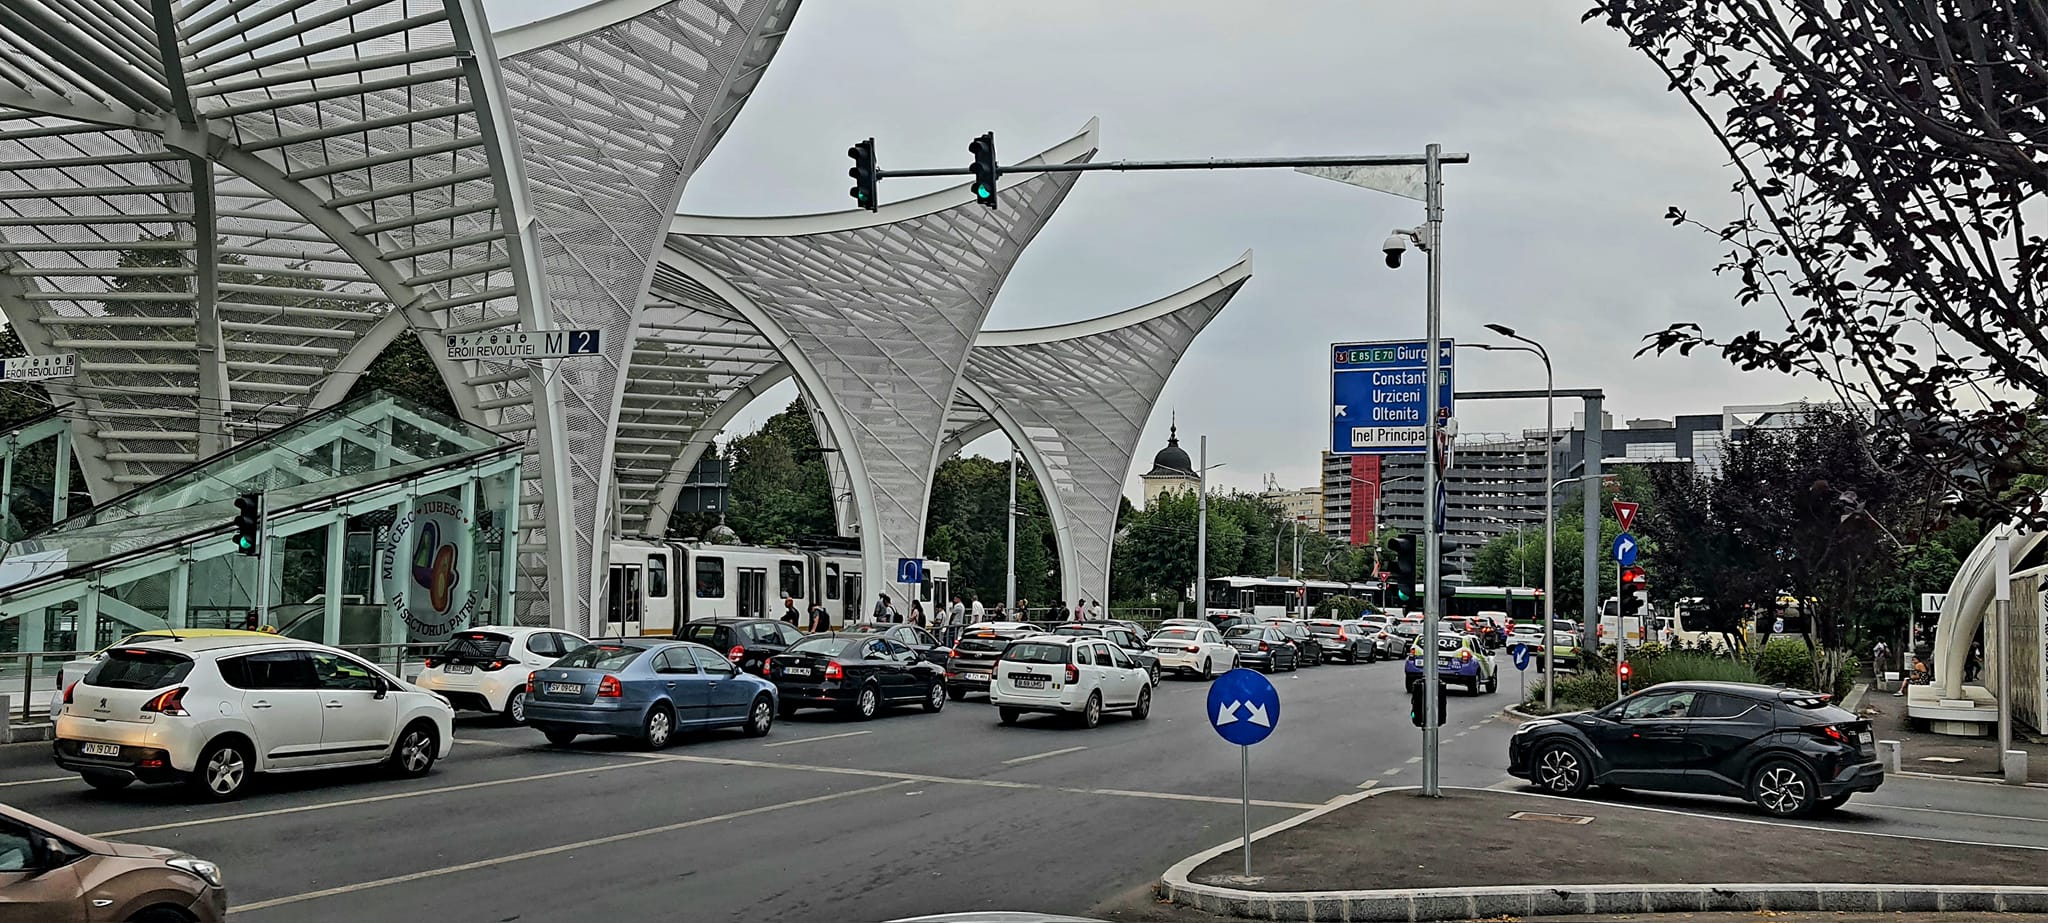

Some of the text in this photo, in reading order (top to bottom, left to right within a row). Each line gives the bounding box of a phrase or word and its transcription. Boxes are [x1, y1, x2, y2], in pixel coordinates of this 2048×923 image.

[545, 332, 590, 353] M 2
[448, 345, 535, 358] EROII REVOLUTIEI
[1351, 352, 1356, 361] E
[1360, 352, 1369, 360] 85
[1374, 351, 1380, 360] E
[6, 366, 72, 379] EROII REVOLUTIEI
[1372, 389, 1420, 403] Urziceni
[1353, 428, 1425, 444] Inel Principa
[423, 501, 463, 520] IUBESC
[383, 511, 415, 580] MUNCESC
[392, 591, 479, 636] ÎN SECTORUL PATRU
[86, 743, 95, 752] VN
